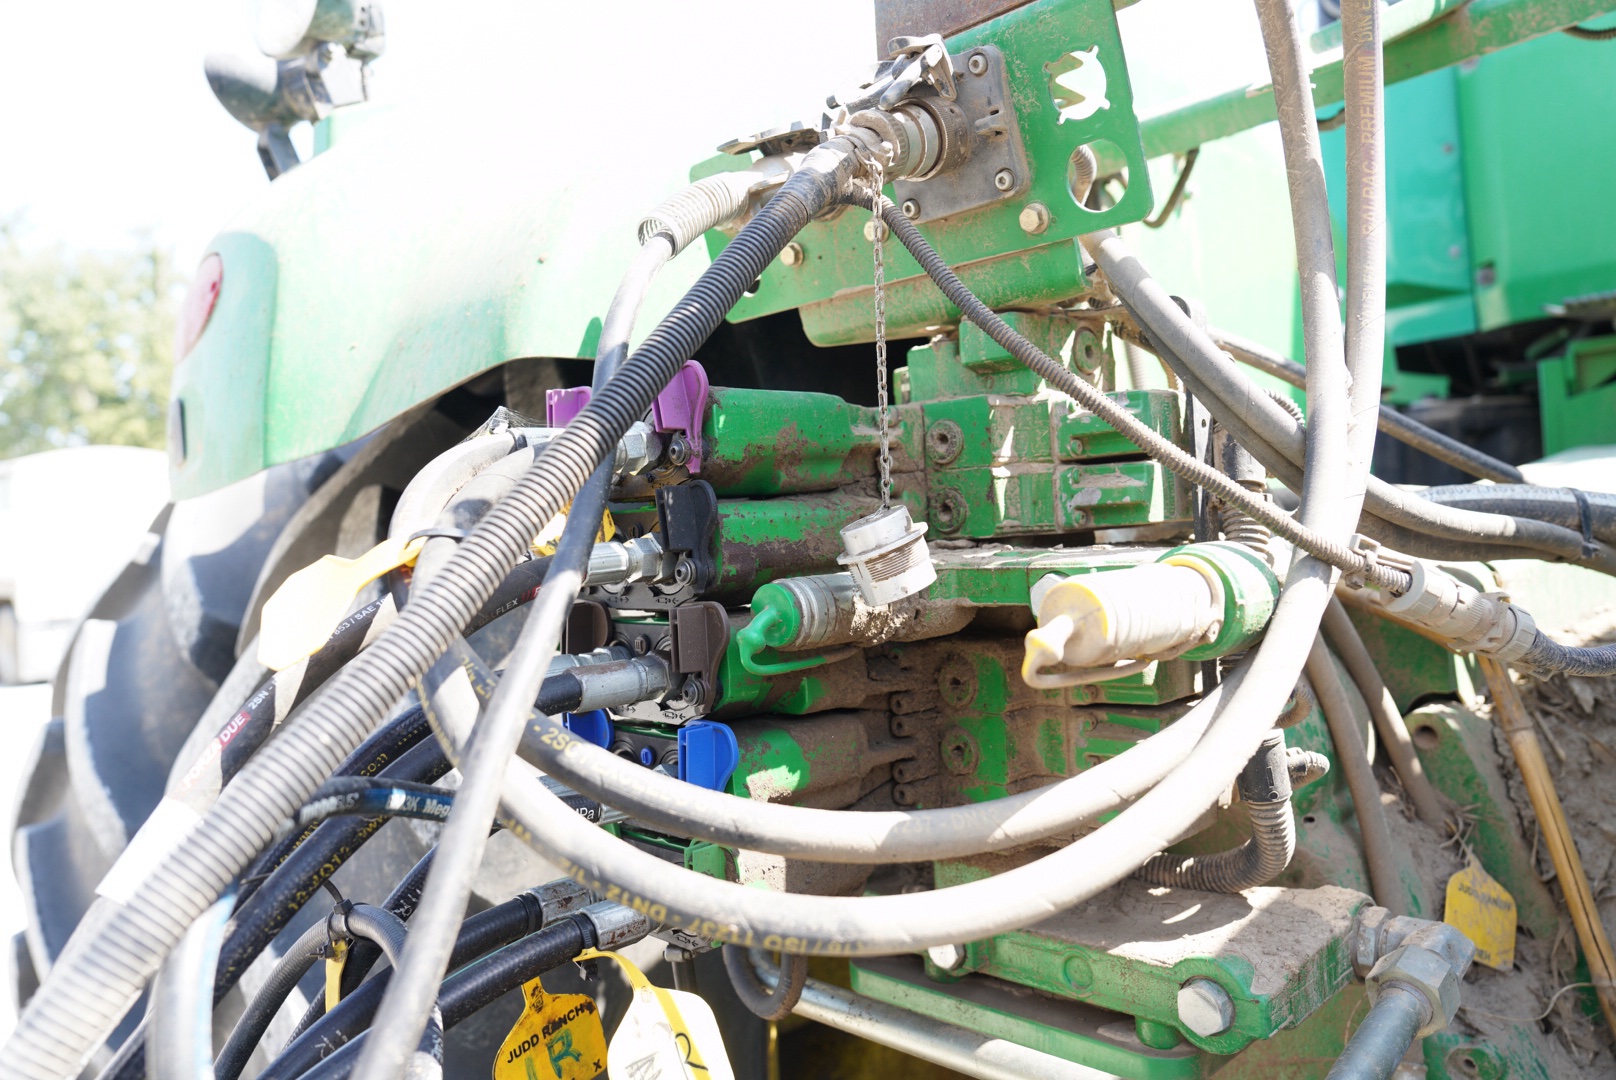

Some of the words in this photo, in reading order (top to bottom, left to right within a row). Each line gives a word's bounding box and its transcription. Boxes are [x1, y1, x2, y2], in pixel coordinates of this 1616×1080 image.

[1358, 56, 1376, 144] PREMIUM
[218, 712, 247, 743] DUE
[248, 687, 270, 709] 2SN
[355, 604, 377, 621] SAE
[422, 798, 454, 818] Meg
[576, 807, 595, 820] Pa
[605, 884, 668, 922] DN12
[762, 934, 808, 953] ISO
[507, 1034, 540, 1064] JUDD
[542, 1003, 586, 1040] RANCH
